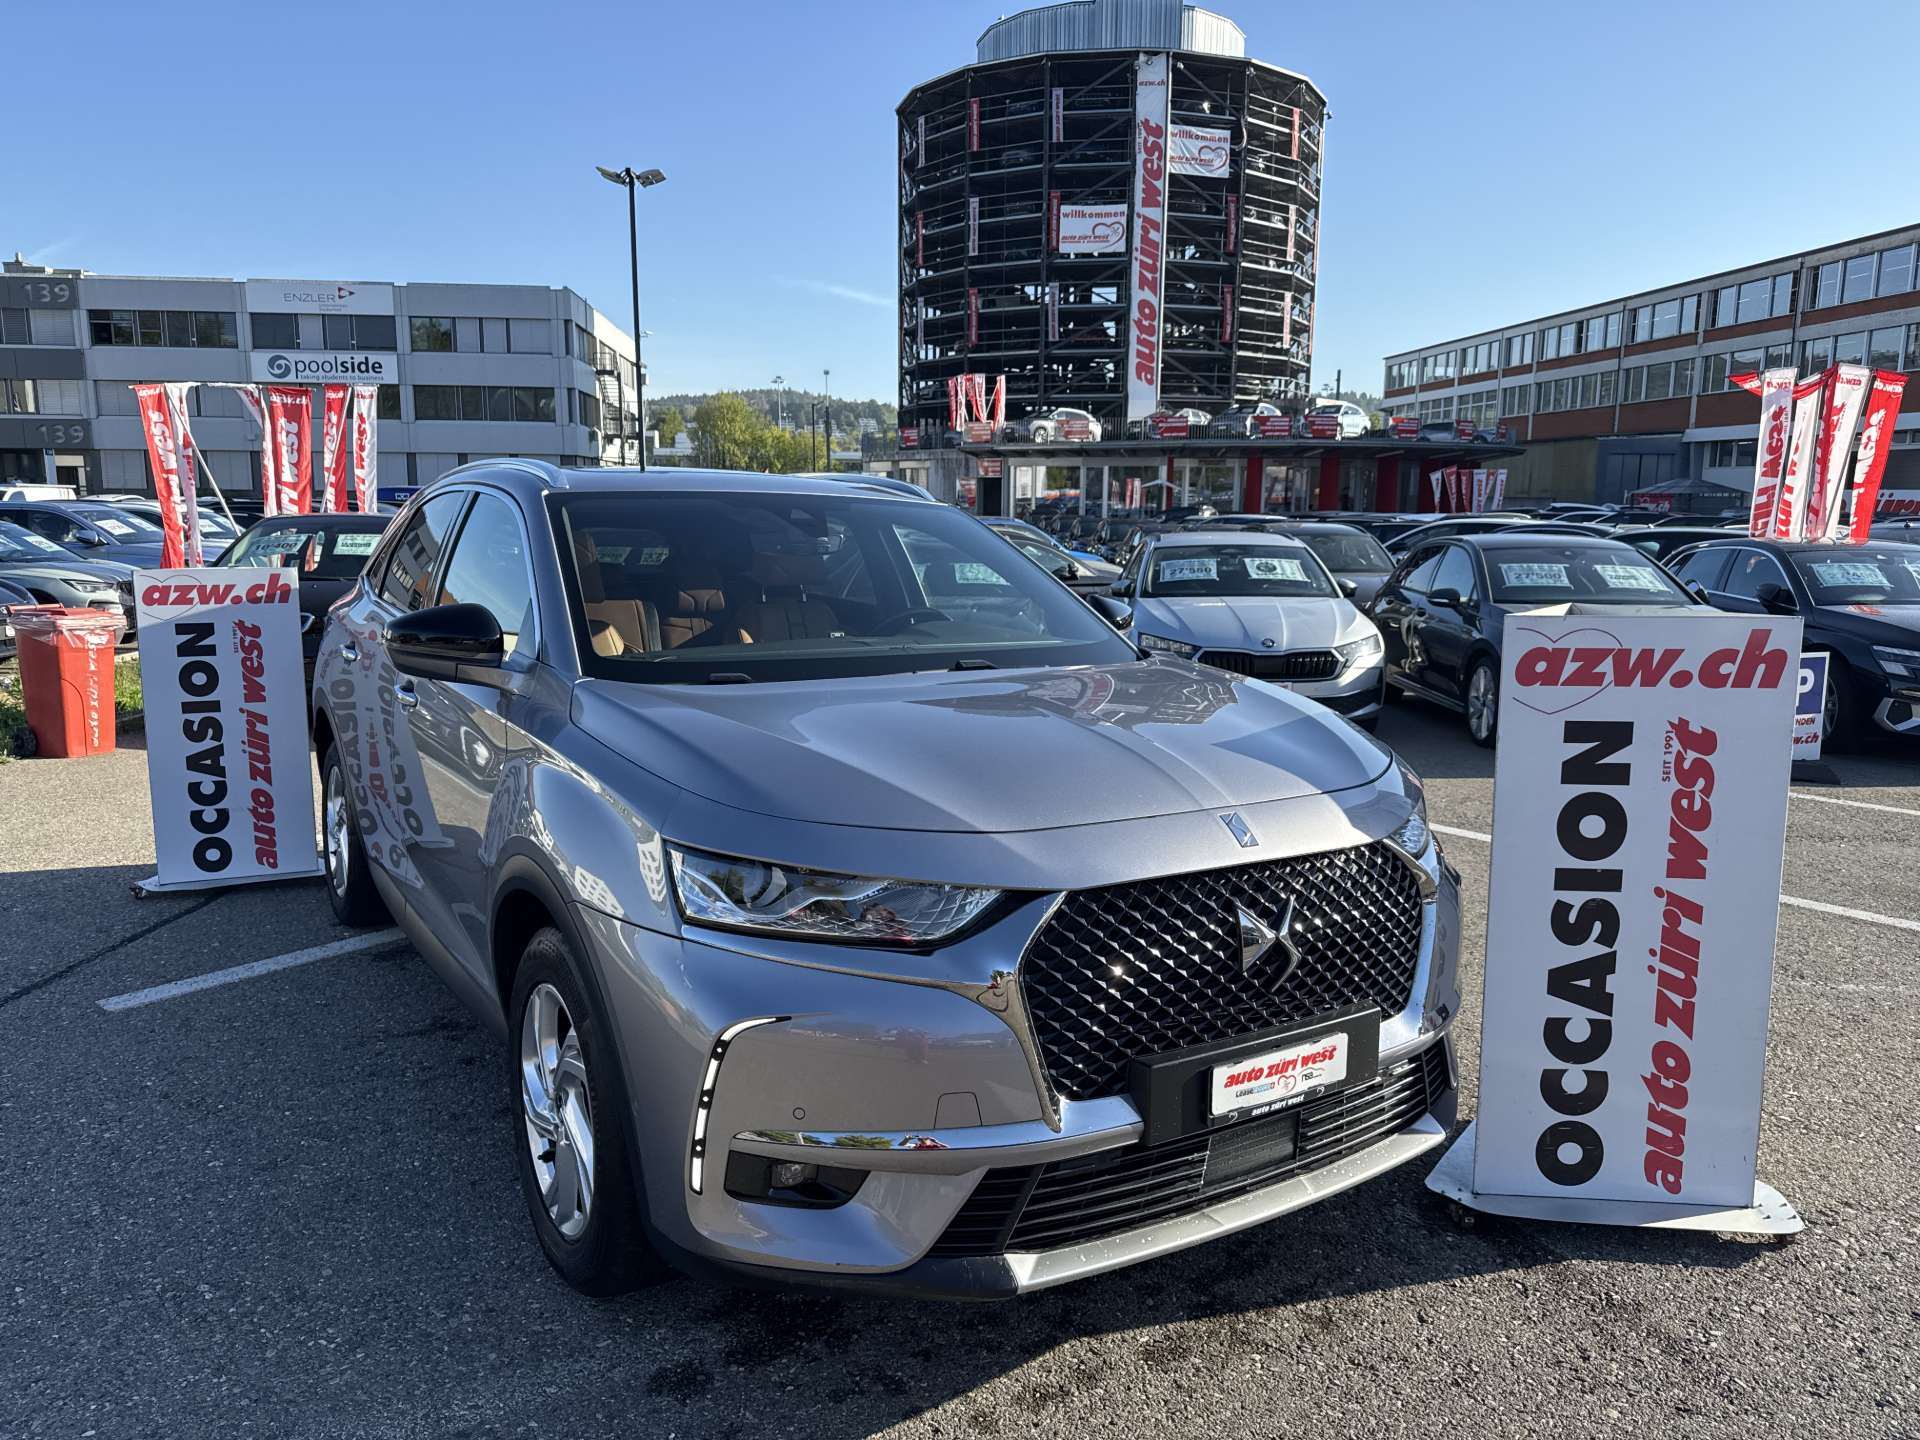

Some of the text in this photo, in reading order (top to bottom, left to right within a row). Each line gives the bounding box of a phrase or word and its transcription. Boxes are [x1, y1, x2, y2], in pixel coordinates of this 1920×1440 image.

[1138, 79, 1166, 87] azw.ch
[1170, 129, 1229, 144] willkommen
[1062, 209, 1125, 219] willkommen
[1132, 117, 1164, 387] auto züri west
[24, 283, 71, 303] 139
[284, 292, 336, 303] ENZLER
[294, 355, 383, 379] poolside
[37, 424, 84, 444] 139
[148, 408, 177, 471] west
[279, 415, 299, 483] west
[356, 411, 367, 470] west
[142, 574, 291, 606] azw.ch
[1514, 628, 1788, 689] azw.ch
[1798, 668, 1815, 694] P
[175, 622, 233, 873] OCCASION
[232, 619, 278, 870] auto züri west
[1662, 730, 1674, 783] SEIT 1991
[1535, 720, 1635, 1187] OCCASION
[1640, 716, 1719, 1195] auto züri west
[1224, 1045, 1337, 1088] auto züri west
[1251, 1095, 1304, 1116] auto züri west
